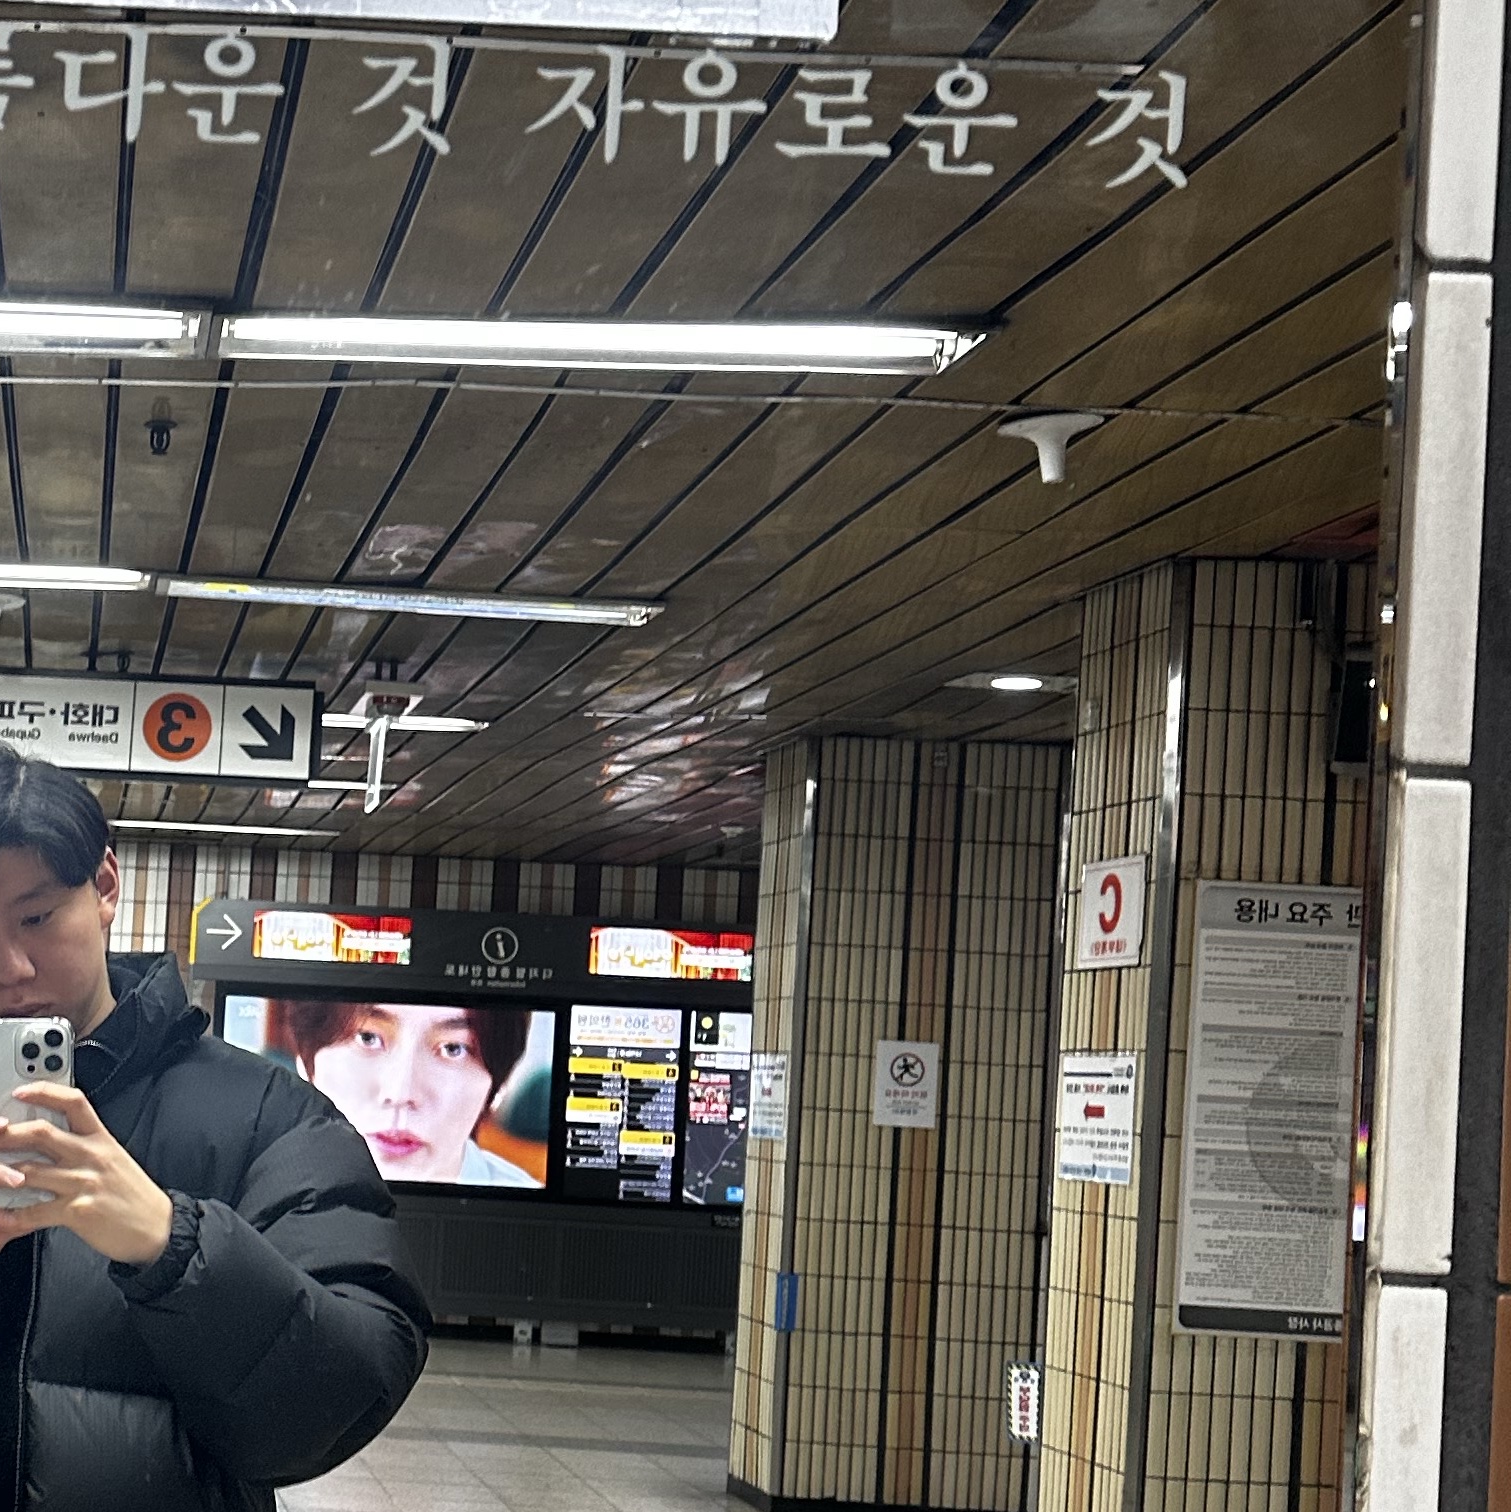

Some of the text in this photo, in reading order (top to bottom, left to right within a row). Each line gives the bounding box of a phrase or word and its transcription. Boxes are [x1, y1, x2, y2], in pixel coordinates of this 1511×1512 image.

[352, 37, 452, 156] 것
[524, 44, 1019, 176] 자유로운
[1087, 69, 1190, 190] 것
